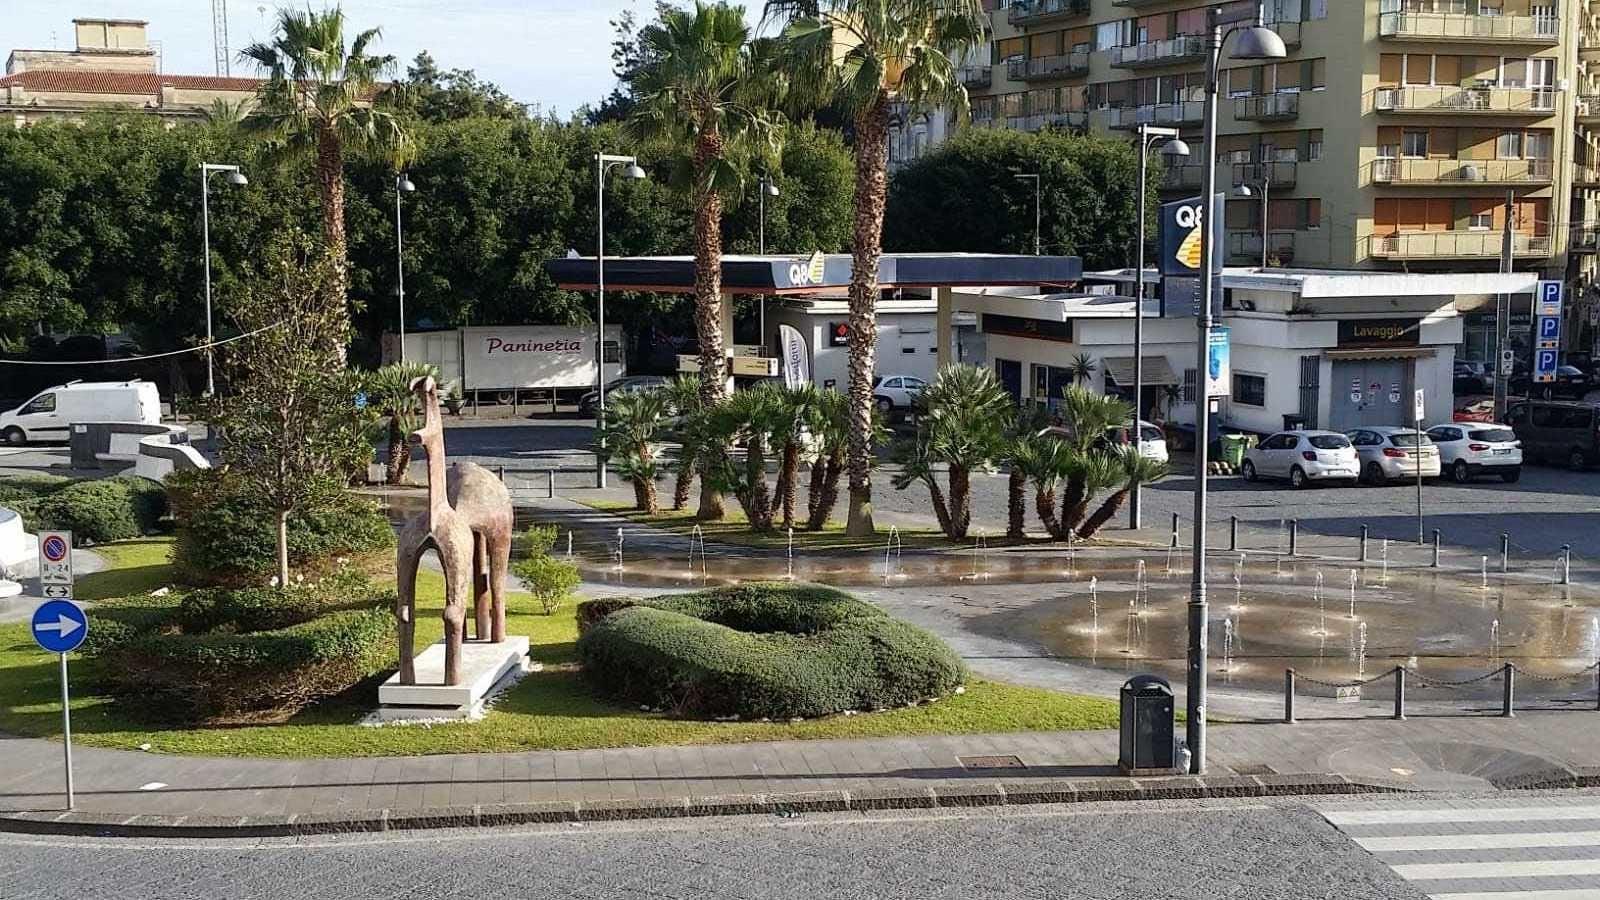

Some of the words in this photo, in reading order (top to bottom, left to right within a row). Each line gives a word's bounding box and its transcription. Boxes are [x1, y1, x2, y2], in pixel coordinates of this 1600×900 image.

[790, 263, 809, 286] Q8
[1546, 284, 1557, 301] P
[1353, 324, 1404, 340] Lavaggio
[1544, 319, 1556, 335] P
[486, 337, 581, 354] Panineria
[1541, 352, 1553, 369] P
